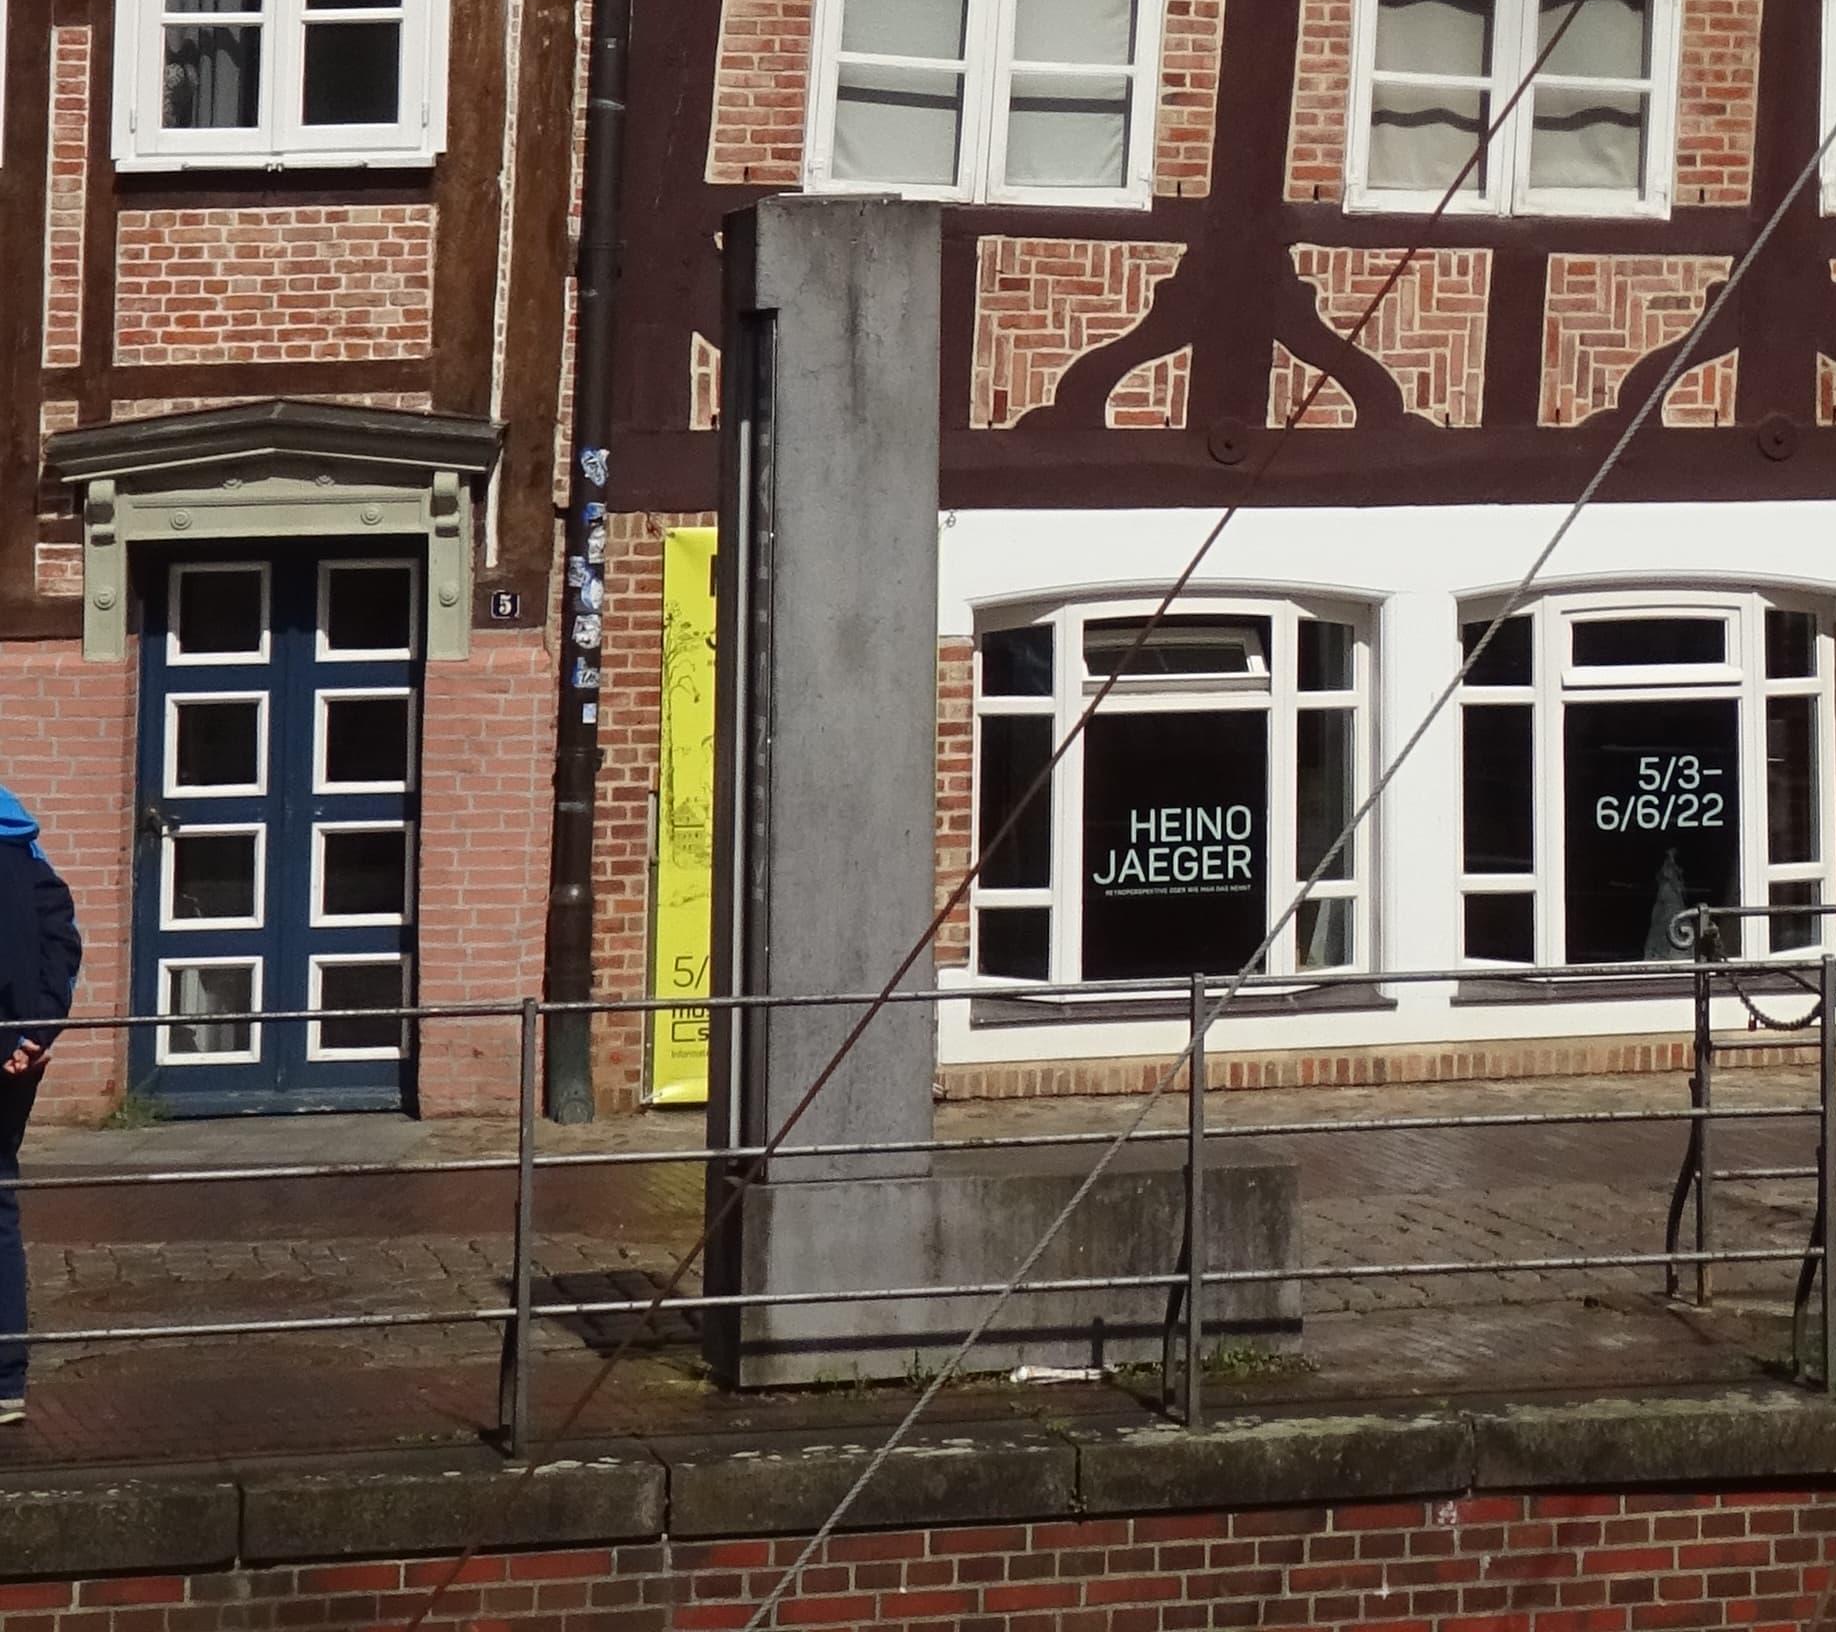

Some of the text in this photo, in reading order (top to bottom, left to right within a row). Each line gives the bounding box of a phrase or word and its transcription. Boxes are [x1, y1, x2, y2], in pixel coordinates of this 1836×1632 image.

[499, 594, 512, 615] 5
[1131, 805, 1252, 843] HEINO
[1596, 793, 1723, 832] 6/6/22
[1093, 845, 1252, 885] JAEGER
